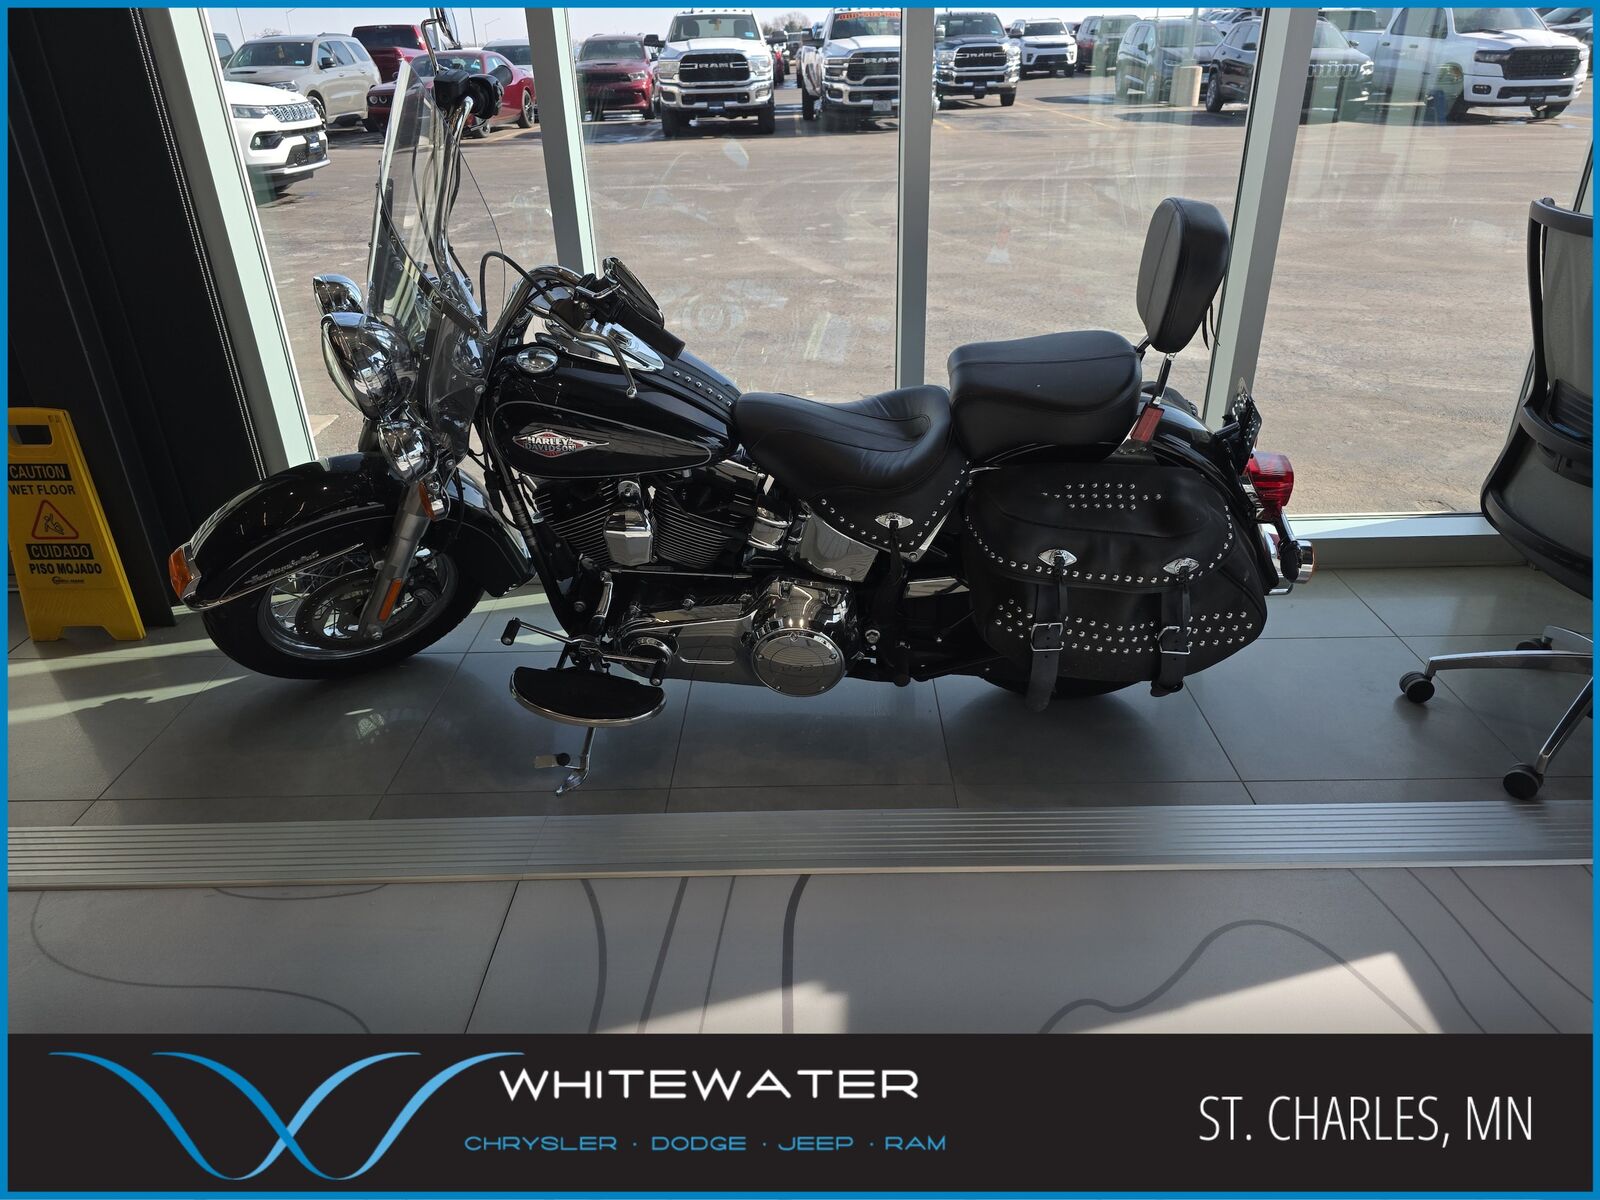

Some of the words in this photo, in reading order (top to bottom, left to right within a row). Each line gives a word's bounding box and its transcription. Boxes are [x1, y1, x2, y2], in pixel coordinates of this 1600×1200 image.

[526, 436, 570, 445] HARLEY
[9, 465, 66, 479] CAUTION
[9, 484, 34, 495] WET
[36, 484, 76, 495] FLOOR
[31, 545, 90, 558] CUIDADO
[29, 563, 55, 575] PISO
[56, 563, 102, 575] MOJADO
